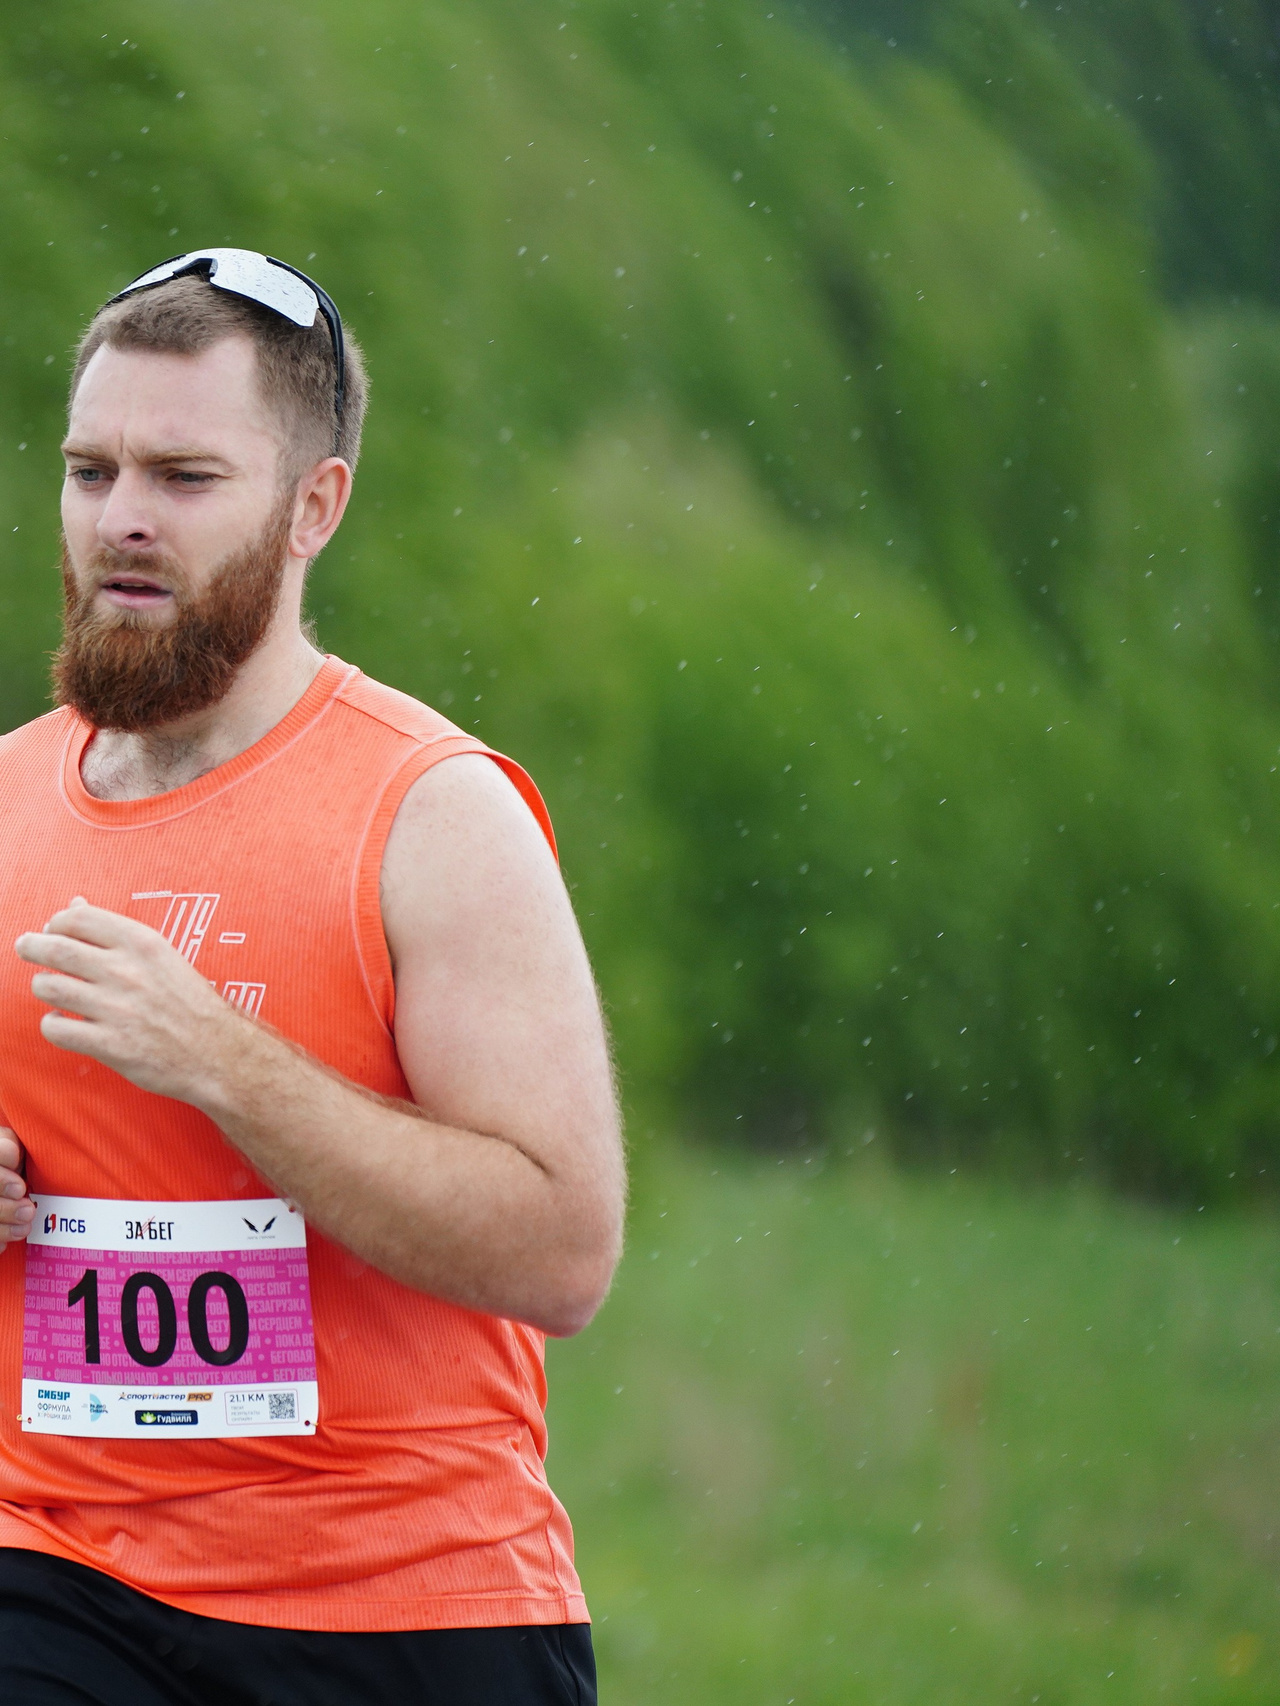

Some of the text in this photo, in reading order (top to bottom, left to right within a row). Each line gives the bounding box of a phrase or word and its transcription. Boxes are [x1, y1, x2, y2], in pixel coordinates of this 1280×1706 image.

[59, 1217, 86, 1234] ПСБ
[118, 1251, 155, 1264] БЕГОВАЯ
[156, 1251, 223, 1264] ПЕРЕЗАГРУЗКА
[240, 1249, 277, 1263] СТРЕСС
[236, 1265, 275, 1281] ФИНИШ
[247, 1282, 266, 1297] ВСЕ
[267, 1281, 291, 1296] СПЯТ
[67, 1268, 249, 1369] 100
[258, 1316, 302, 1333] СЕРДЦЕМ
[275, 1333, 301, 1348] ПОКА
[58, 1350, 84, 1366] СТРЕСС
[270, 1349, 313, 1365] БЕГОВАЯ
[91, 1370, 124, 1385] ТОЛЬКО
[124, 1371, 159, 1386] НАЧАЛО
[173, 1371, 186, 1386] НА
[187, 1370, 221, 1386] СТАРТЕ
[221, 1369, 257, 1385] ЖИЗНИ
[273, 1368, 296, 1383] БЕГУ
[38, 1389, 70, 1401] СИБУР
[189, 1393, 212, 1401] PRO
[37, 1402, 71, 1413] ФОРМУЛА
